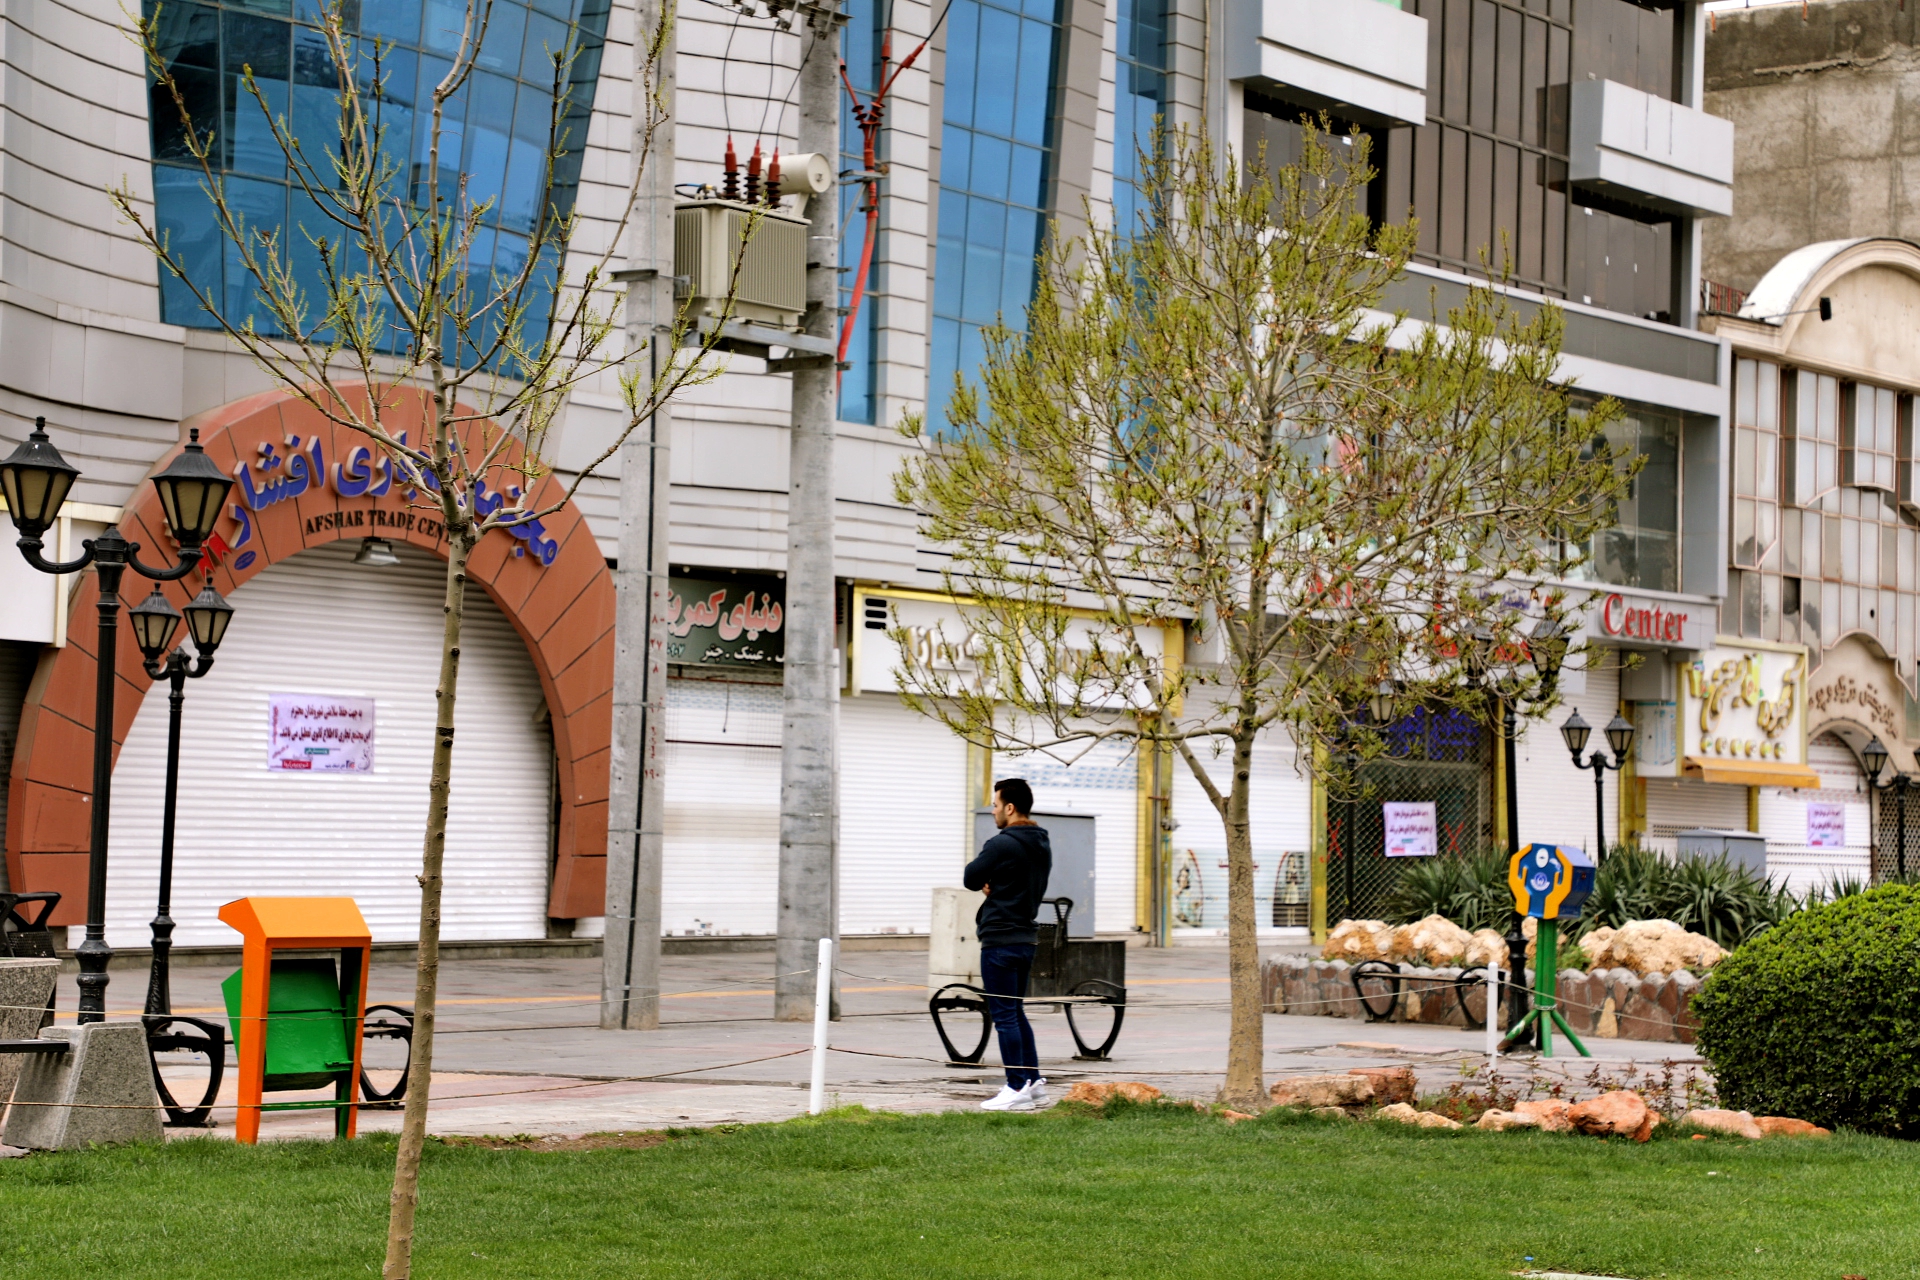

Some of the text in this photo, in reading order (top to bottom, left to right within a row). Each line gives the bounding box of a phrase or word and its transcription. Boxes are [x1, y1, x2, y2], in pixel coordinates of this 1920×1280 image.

[228, 433, 325, 550] افشار
[305, 509, 450, 543] AFSHAR TRADE CEN
[667, 588, 783, 641] دنیای کمربن
[1604, 593, 1689, 643] Center
[733, 645, 765, 665] عینک
